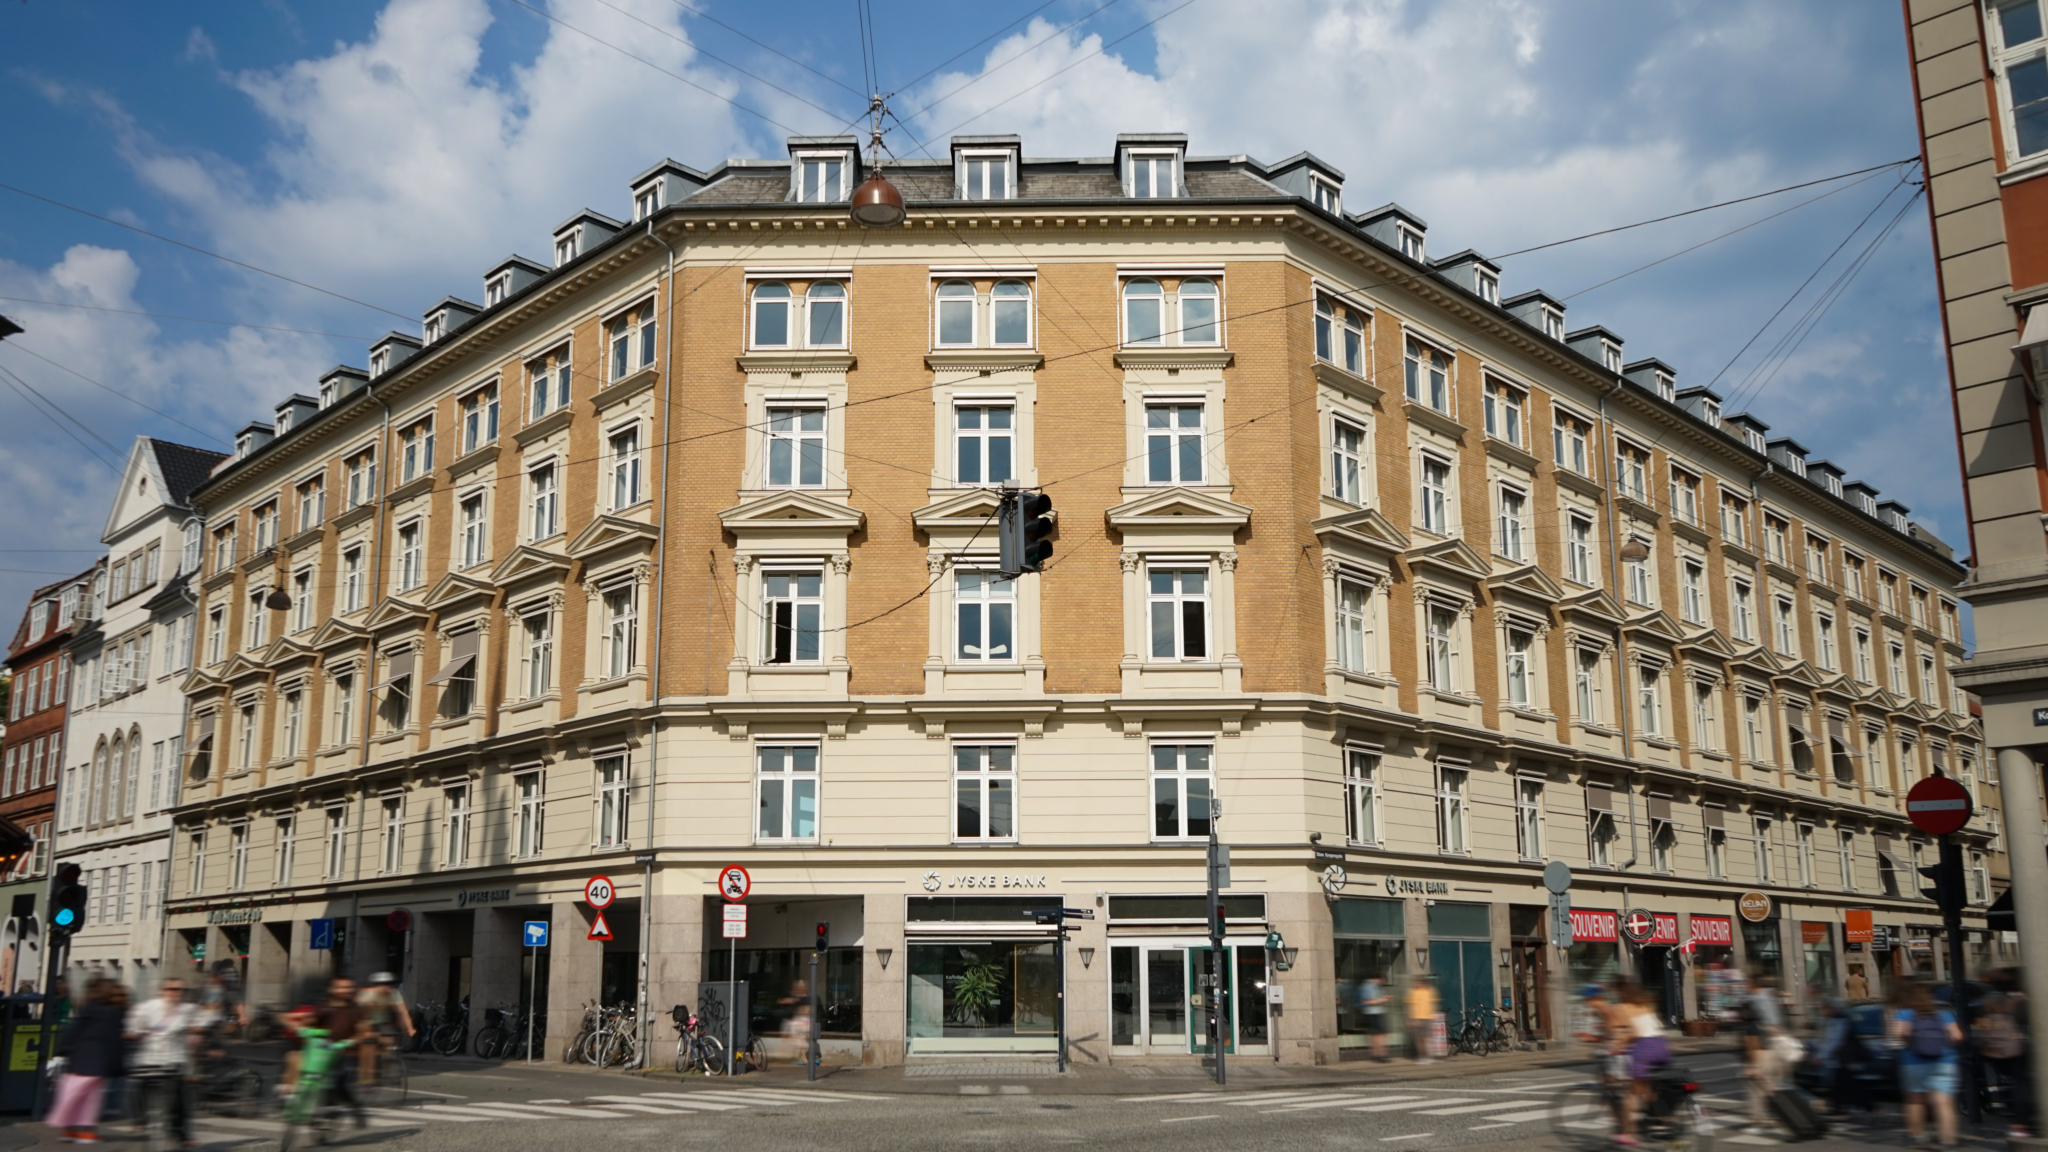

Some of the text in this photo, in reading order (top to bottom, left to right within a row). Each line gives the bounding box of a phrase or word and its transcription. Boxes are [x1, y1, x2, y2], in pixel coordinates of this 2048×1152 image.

[948, 875, 1046, 888] JYSKE BANK
[1399, 880, 1449, 895] JYSKE BANK
[590, 886, 609, 899] 40
[1569, 914, 1616, 938] SOUVENIR
[1691, 919, 1731, 941] SOUVENIR
